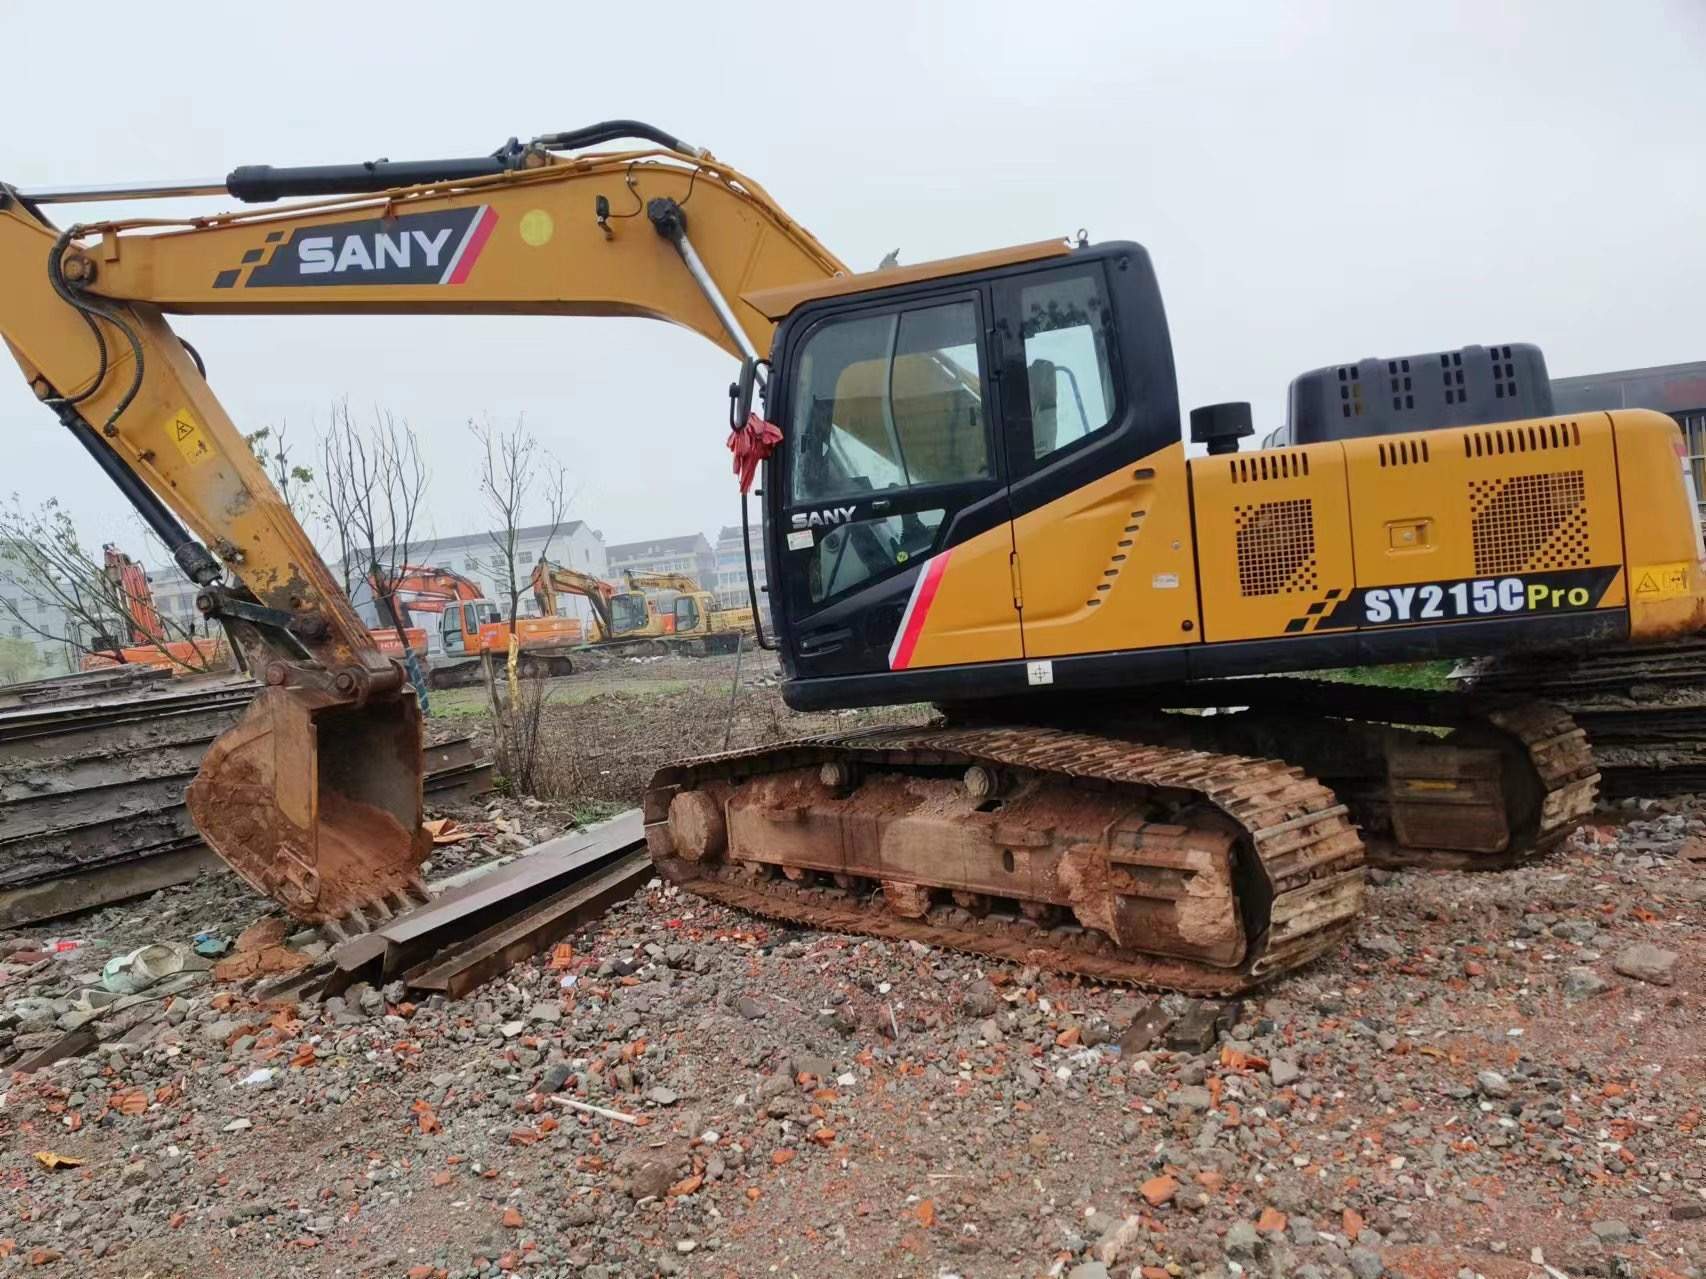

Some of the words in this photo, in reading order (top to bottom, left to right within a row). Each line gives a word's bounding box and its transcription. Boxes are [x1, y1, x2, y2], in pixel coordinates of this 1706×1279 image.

[298, 229, 452, 274] SANY
[791, 506, 856, 528] SANY
[1365, 579, 1525, 622] SY215C
[1528, 584, 1590, 609] Pro
